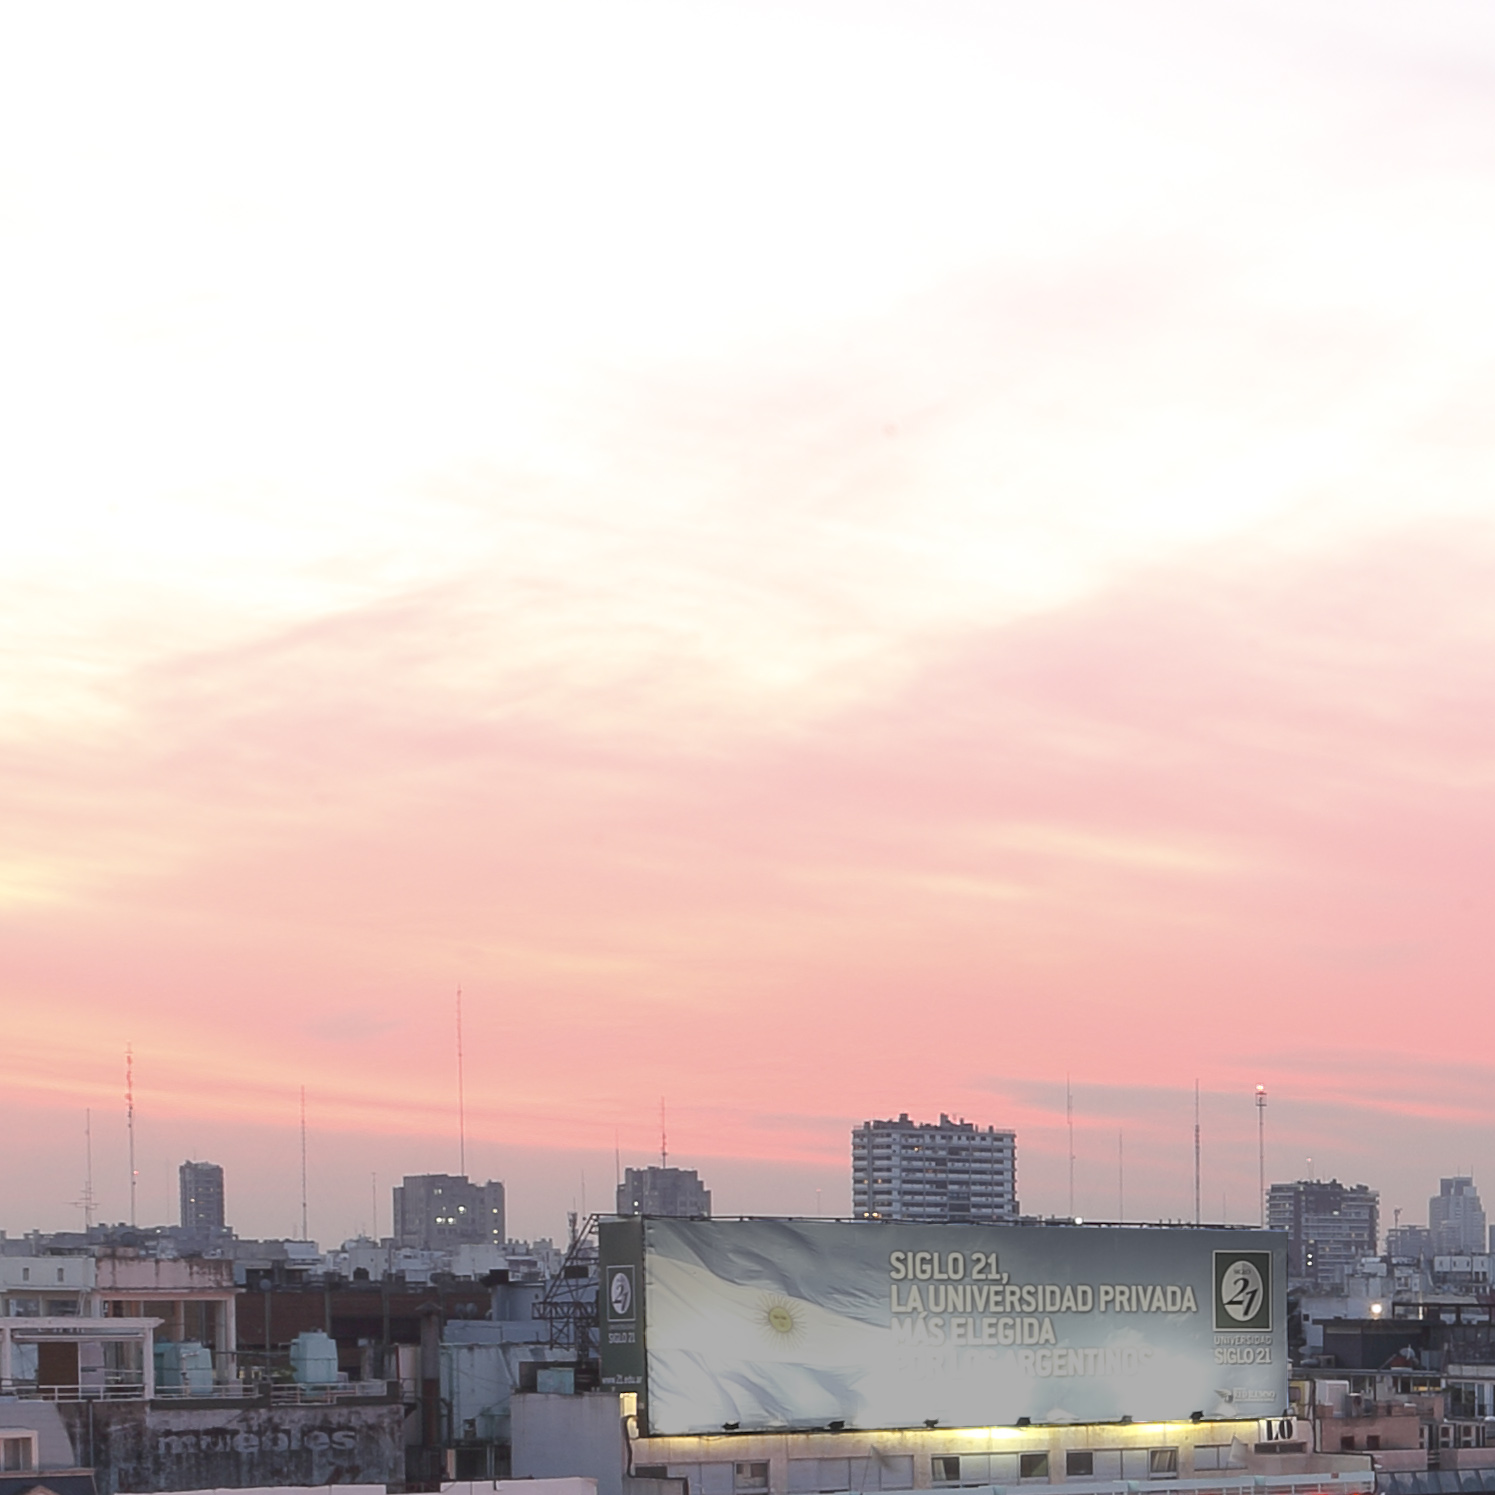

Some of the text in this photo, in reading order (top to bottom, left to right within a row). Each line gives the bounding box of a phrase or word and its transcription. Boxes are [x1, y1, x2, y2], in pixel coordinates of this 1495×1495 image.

[890, 1251, 1009, 1284] SIGLO 21,
[612, 1284, 629, 1312] 21
[891, 1285, 1198, 1313] LA UNIVERSIDAD PRIVADA
[1223, 1277, 1259, 1317] 21
[890, 1312, 1056, 1347] MÁS ELEGIDA
[1214, 1335, 1273, 1346] UNIVERSIDAD
[1214, 1348, 1272, 1364] SIGLO 21
